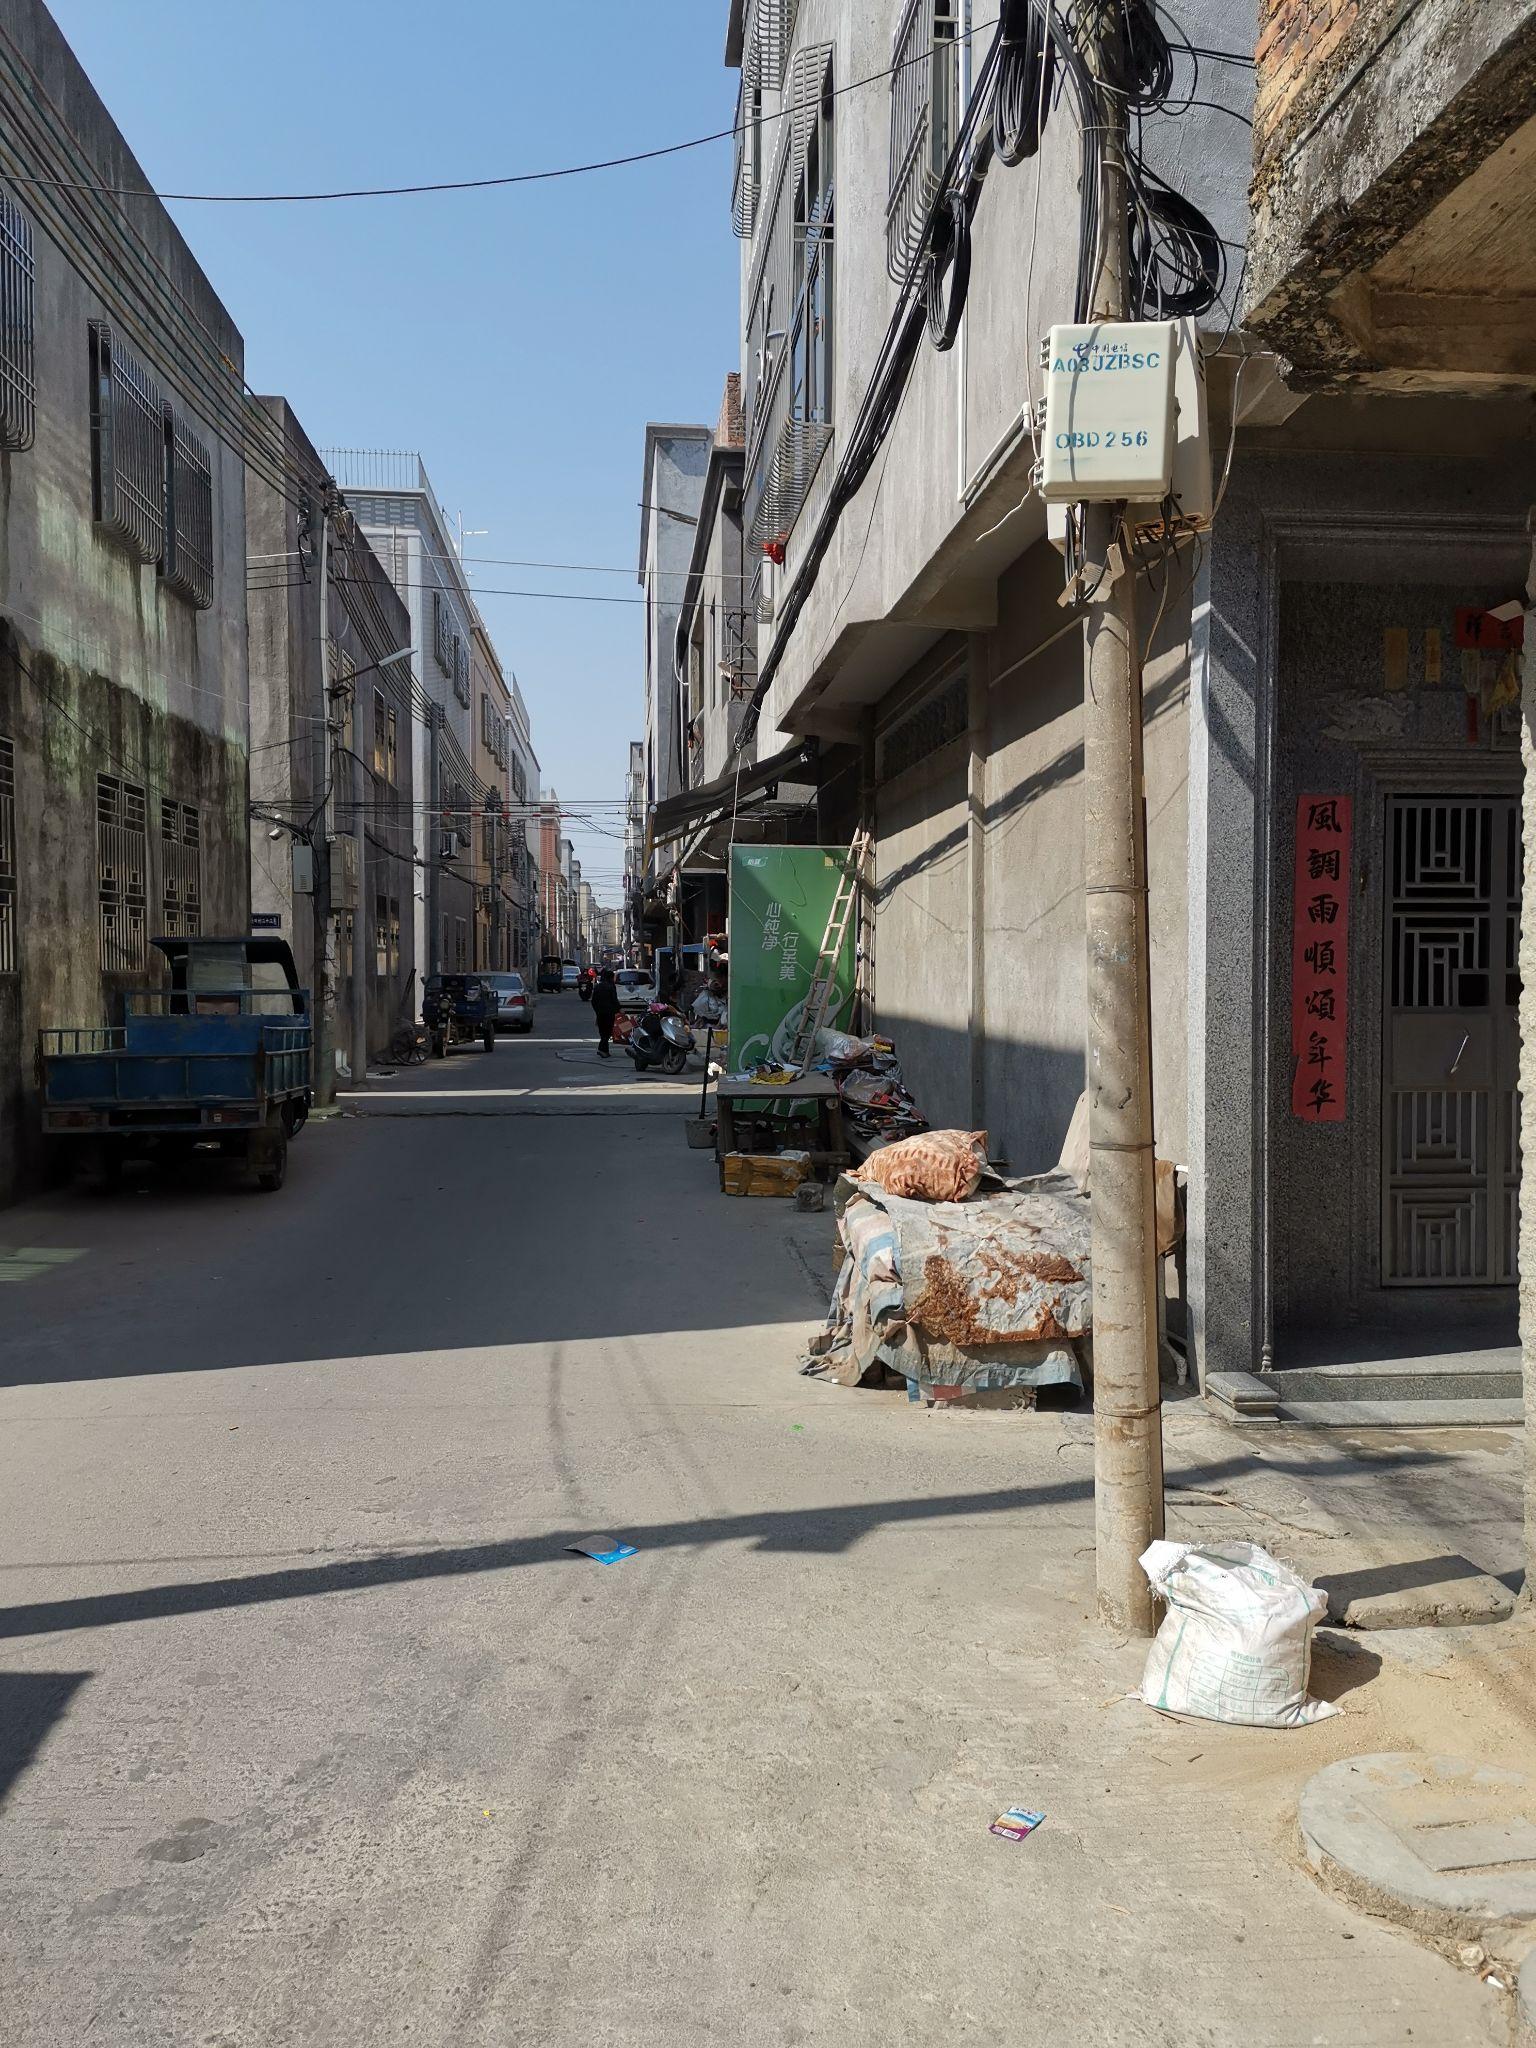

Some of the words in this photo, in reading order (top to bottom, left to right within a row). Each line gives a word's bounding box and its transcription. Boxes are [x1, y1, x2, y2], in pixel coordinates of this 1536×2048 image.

[761, 901, 781, 950] 心纯净
[778, 931, 799, 981] 行至美
